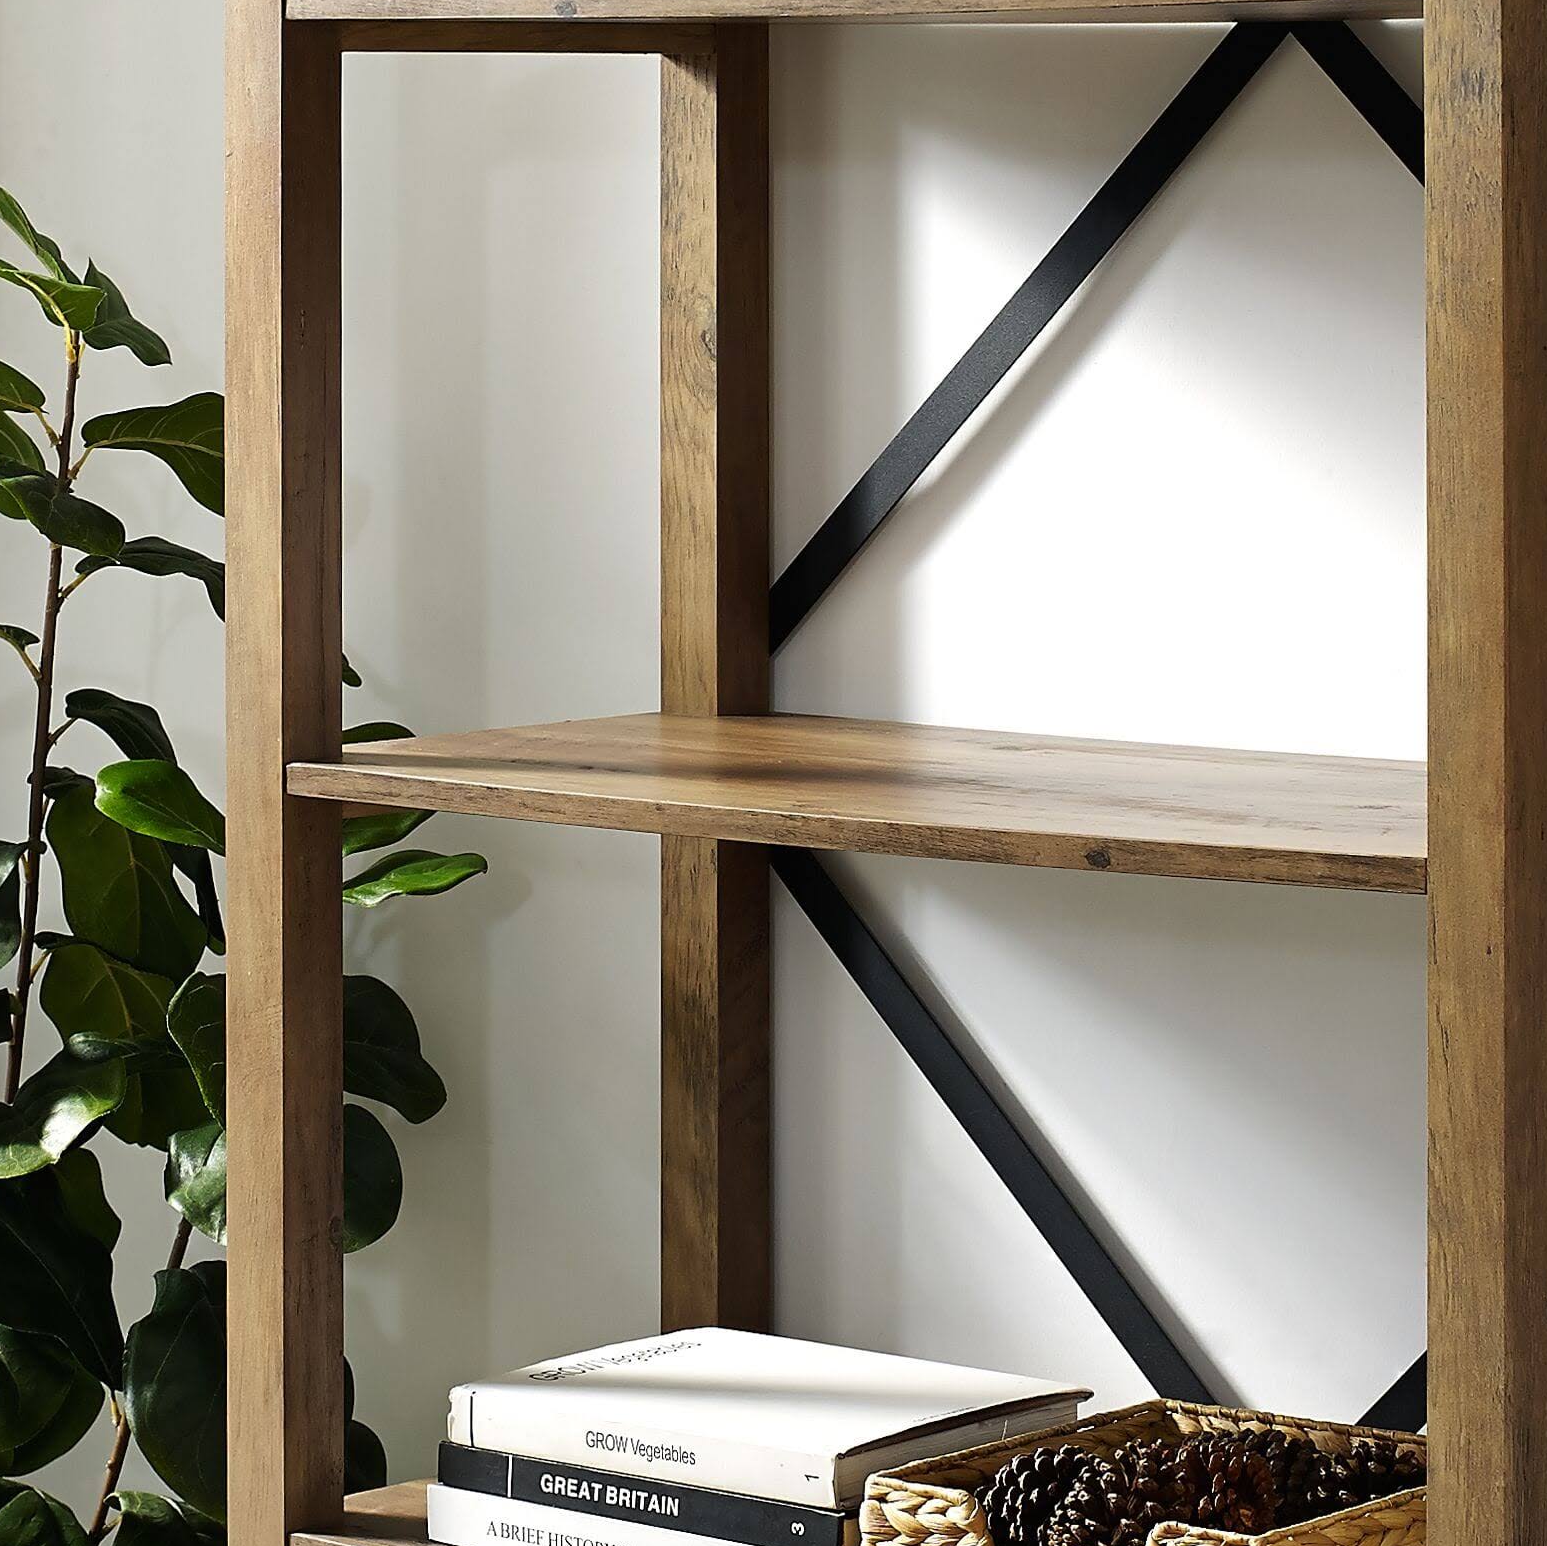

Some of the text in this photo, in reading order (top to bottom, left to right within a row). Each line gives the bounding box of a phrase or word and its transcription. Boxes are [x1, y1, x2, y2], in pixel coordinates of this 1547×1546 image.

[585, 1430, 696, 1465] GROW Vegetables
[804, 1474, 820, 1482] 1
[540, 1474, 679, 1517] GREAT BRITAIN
[486, 1521, 497, 1537] A
[500, 1522, 545, 1546] BRIEF
[791, 1522, 805, 1536] 3
